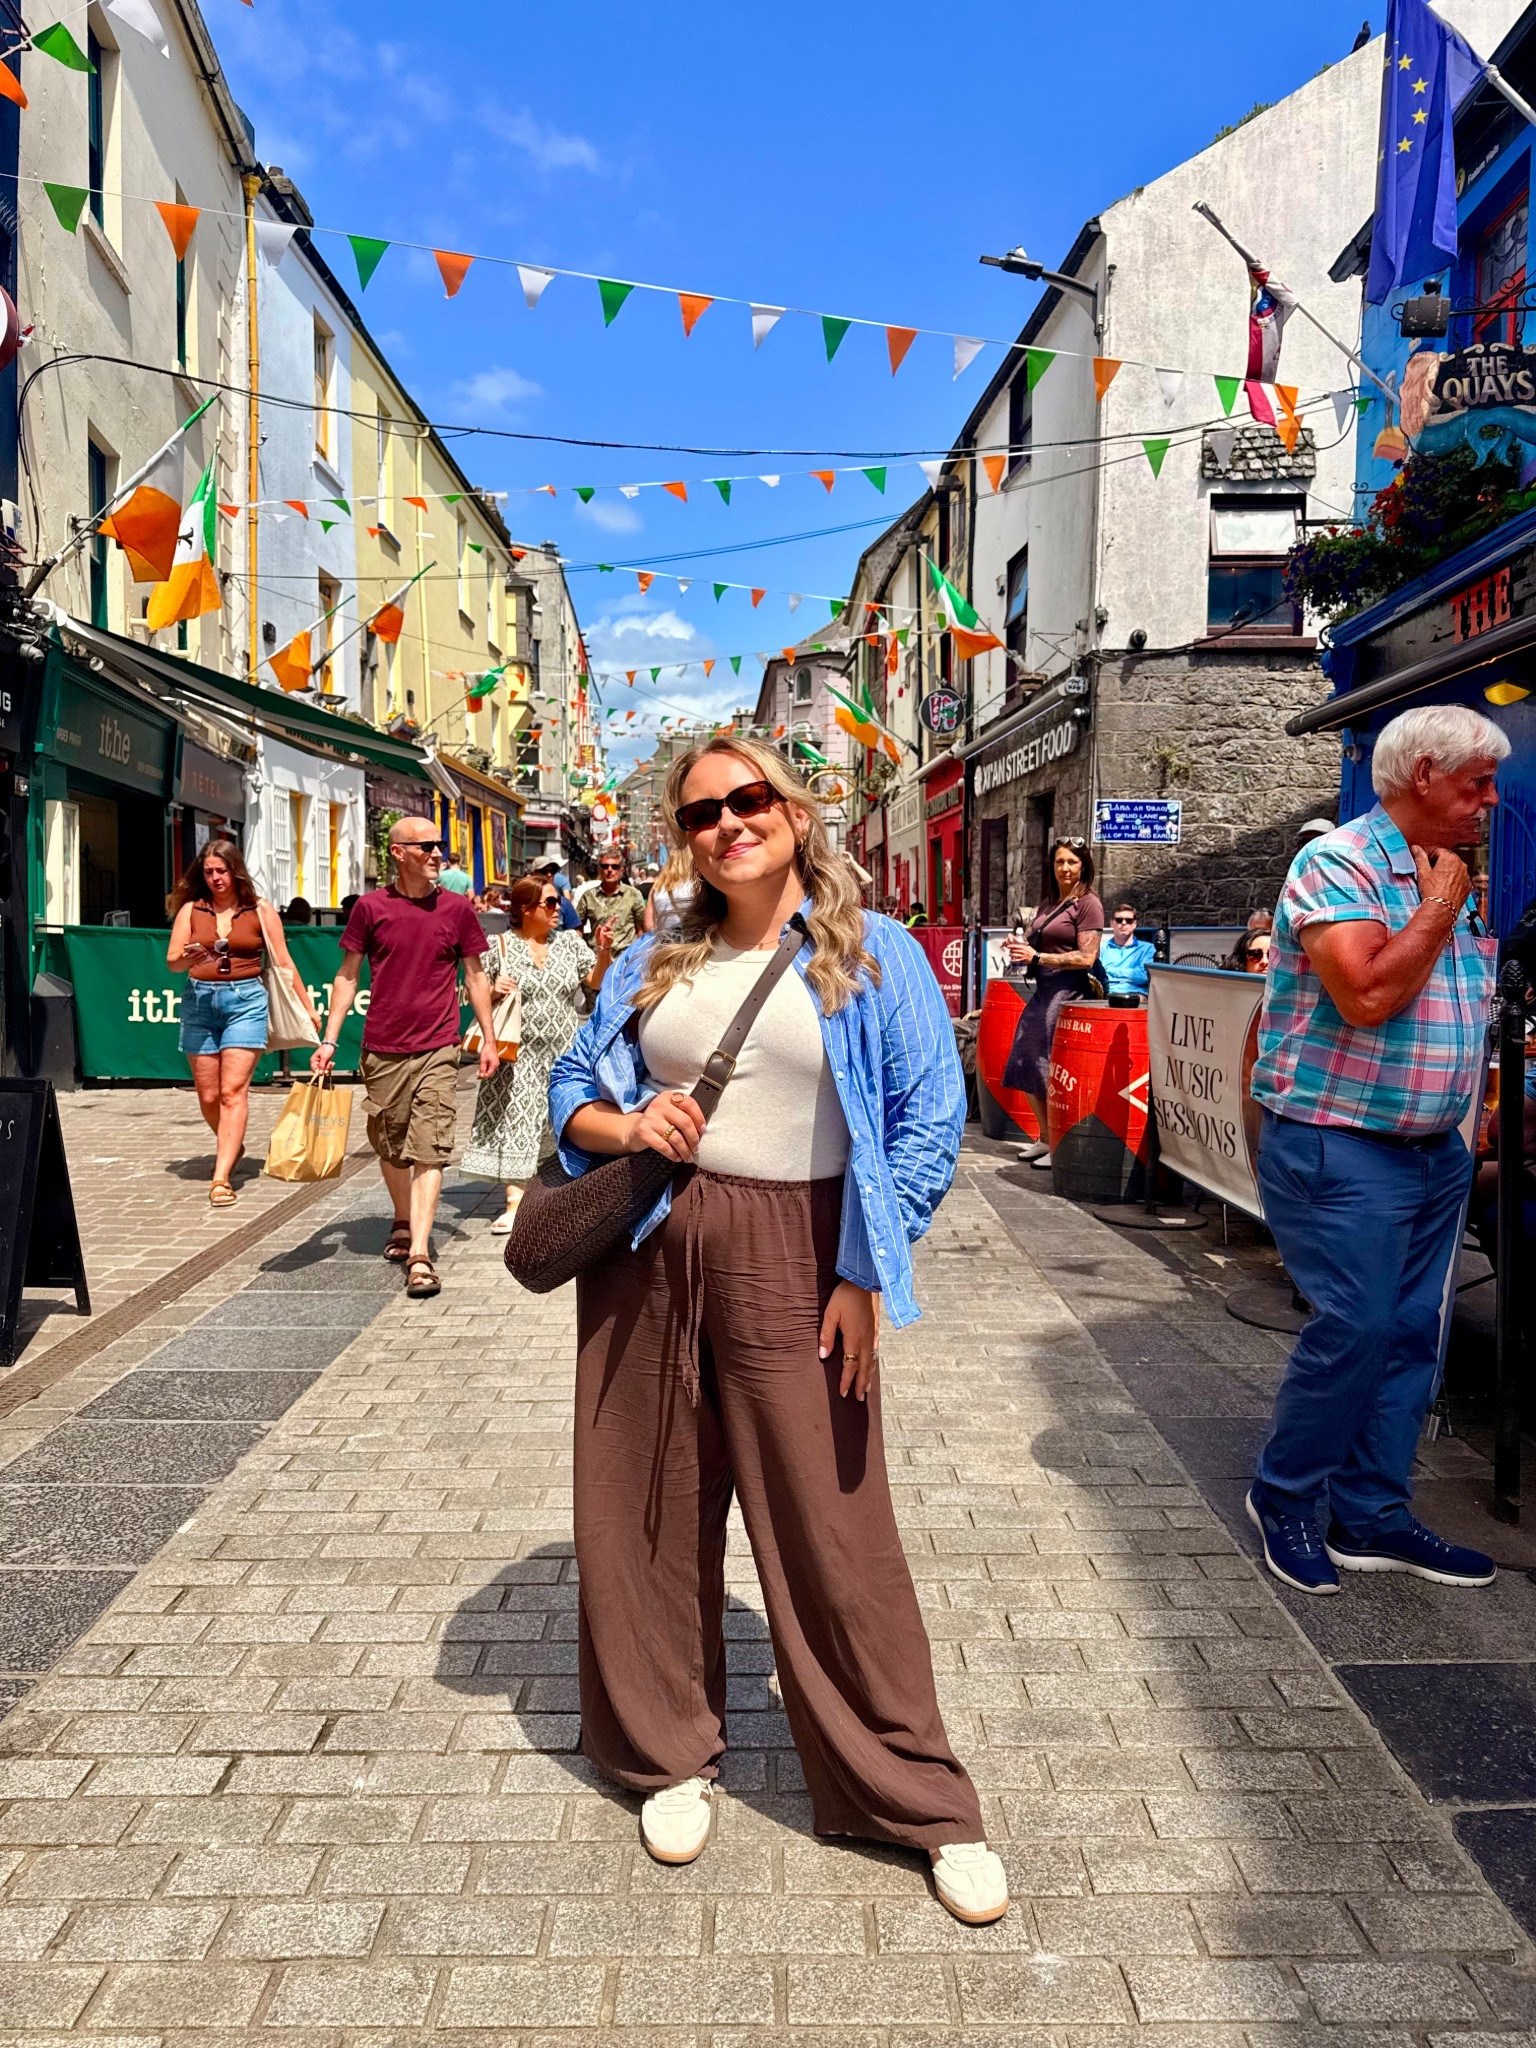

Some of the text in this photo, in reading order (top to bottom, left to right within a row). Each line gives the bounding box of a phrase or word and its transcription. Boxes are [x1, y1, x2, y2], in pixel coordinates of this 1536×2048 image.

[1442, 370, 1536, 410] QUAYS
[1467, 355, 1508, 376] THE
[1449, 566, 1511, 646] THE
[98, 714, 131, 765] ithe
[1005, 738, 1042, 783] STREET
[1041, 720, 1072, 765] FOOD
[1072, 1020, 1092, 1034] BAR
[1170, 1012, 1214, 1053] LIVE
[1164, 1055, 1223, 1104] MUSIC
[1153, 1095, 1236, 1158] SESSIONS
